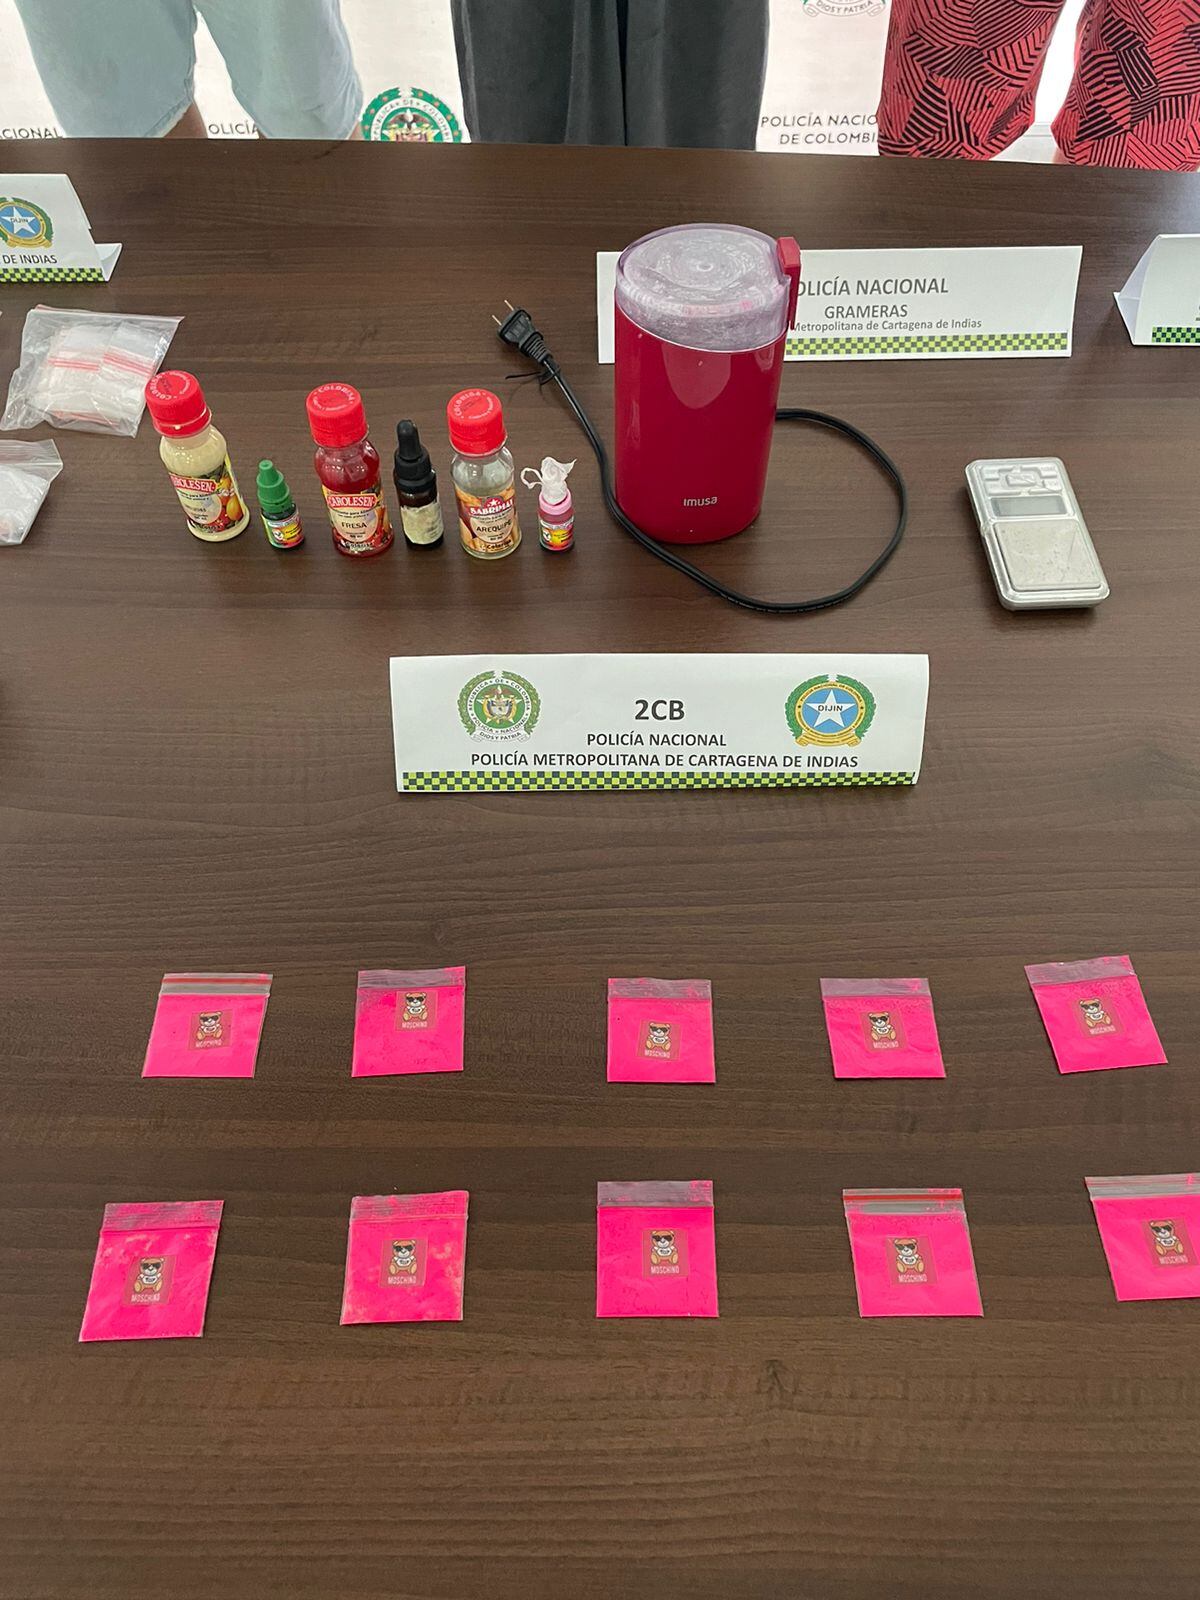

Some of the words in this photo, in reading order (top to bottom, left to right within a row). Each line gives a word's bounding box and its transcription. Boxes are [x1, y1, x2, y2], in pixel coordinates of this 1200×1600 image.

[760, 112, 822, 127] POLICÍA
[828, 114, 878, 126] NACIO
[208, 120, 257, 135] OLICÍ
[0, 127, 63, 139] CIONAL
[779, 133, 800, 145] DE
[804, 132, 876, 145] COLOMBI
[2, 254, 19, 264] DE
[20, 254, 58, 264] INDIAS
[797, 275, 851, 297] OLICÍA
[856, 277, 949, 295] NACIONAL
[824, 304, 908, 319] GRAMERAS
[866, 320, 879, 330] de
[882, 320, 933, 332] Cartagena
[936, 318, 949, 329] de
[952, 317, 982, 329] Indias
[634, 699, 685, 721] 2CB
[817, 704, 843, 712] DIJIN
[587, 731, 644, 746] POLICÍA
[649, 734, 727, 747] NACIONAL
[471, 751, 529, 766] POLICÍA
[533, 753, 660, 767] METROPOLITANA
[665, 754, 684, 767] DE
[688, 755, 778, 768] CARTAGENA
[783, 756, 802, 767] DE
[807, 756, 859, 768] INDIAS
[401, 1021, 428, 1029] MOSCHINO
[1089, 1025, 1117, 1035] MOSCHINO
[195, 1039, 222, 1048] MOSCHINO
[872, 1040, 899, 1048] MOSCHINO
[644, 1050, 671, 1058] MOSCHINO
[1159, 1255, 1188, 1265] MOSCHINO
[650, 1265, 680, 1274] MOSCHINO
[388, 1275, 417, 1285] MOSCHINO
[898, 1274, 928, 1283] MOSCHINO
[130, 1293, 160, 1303] MOSCHINO
